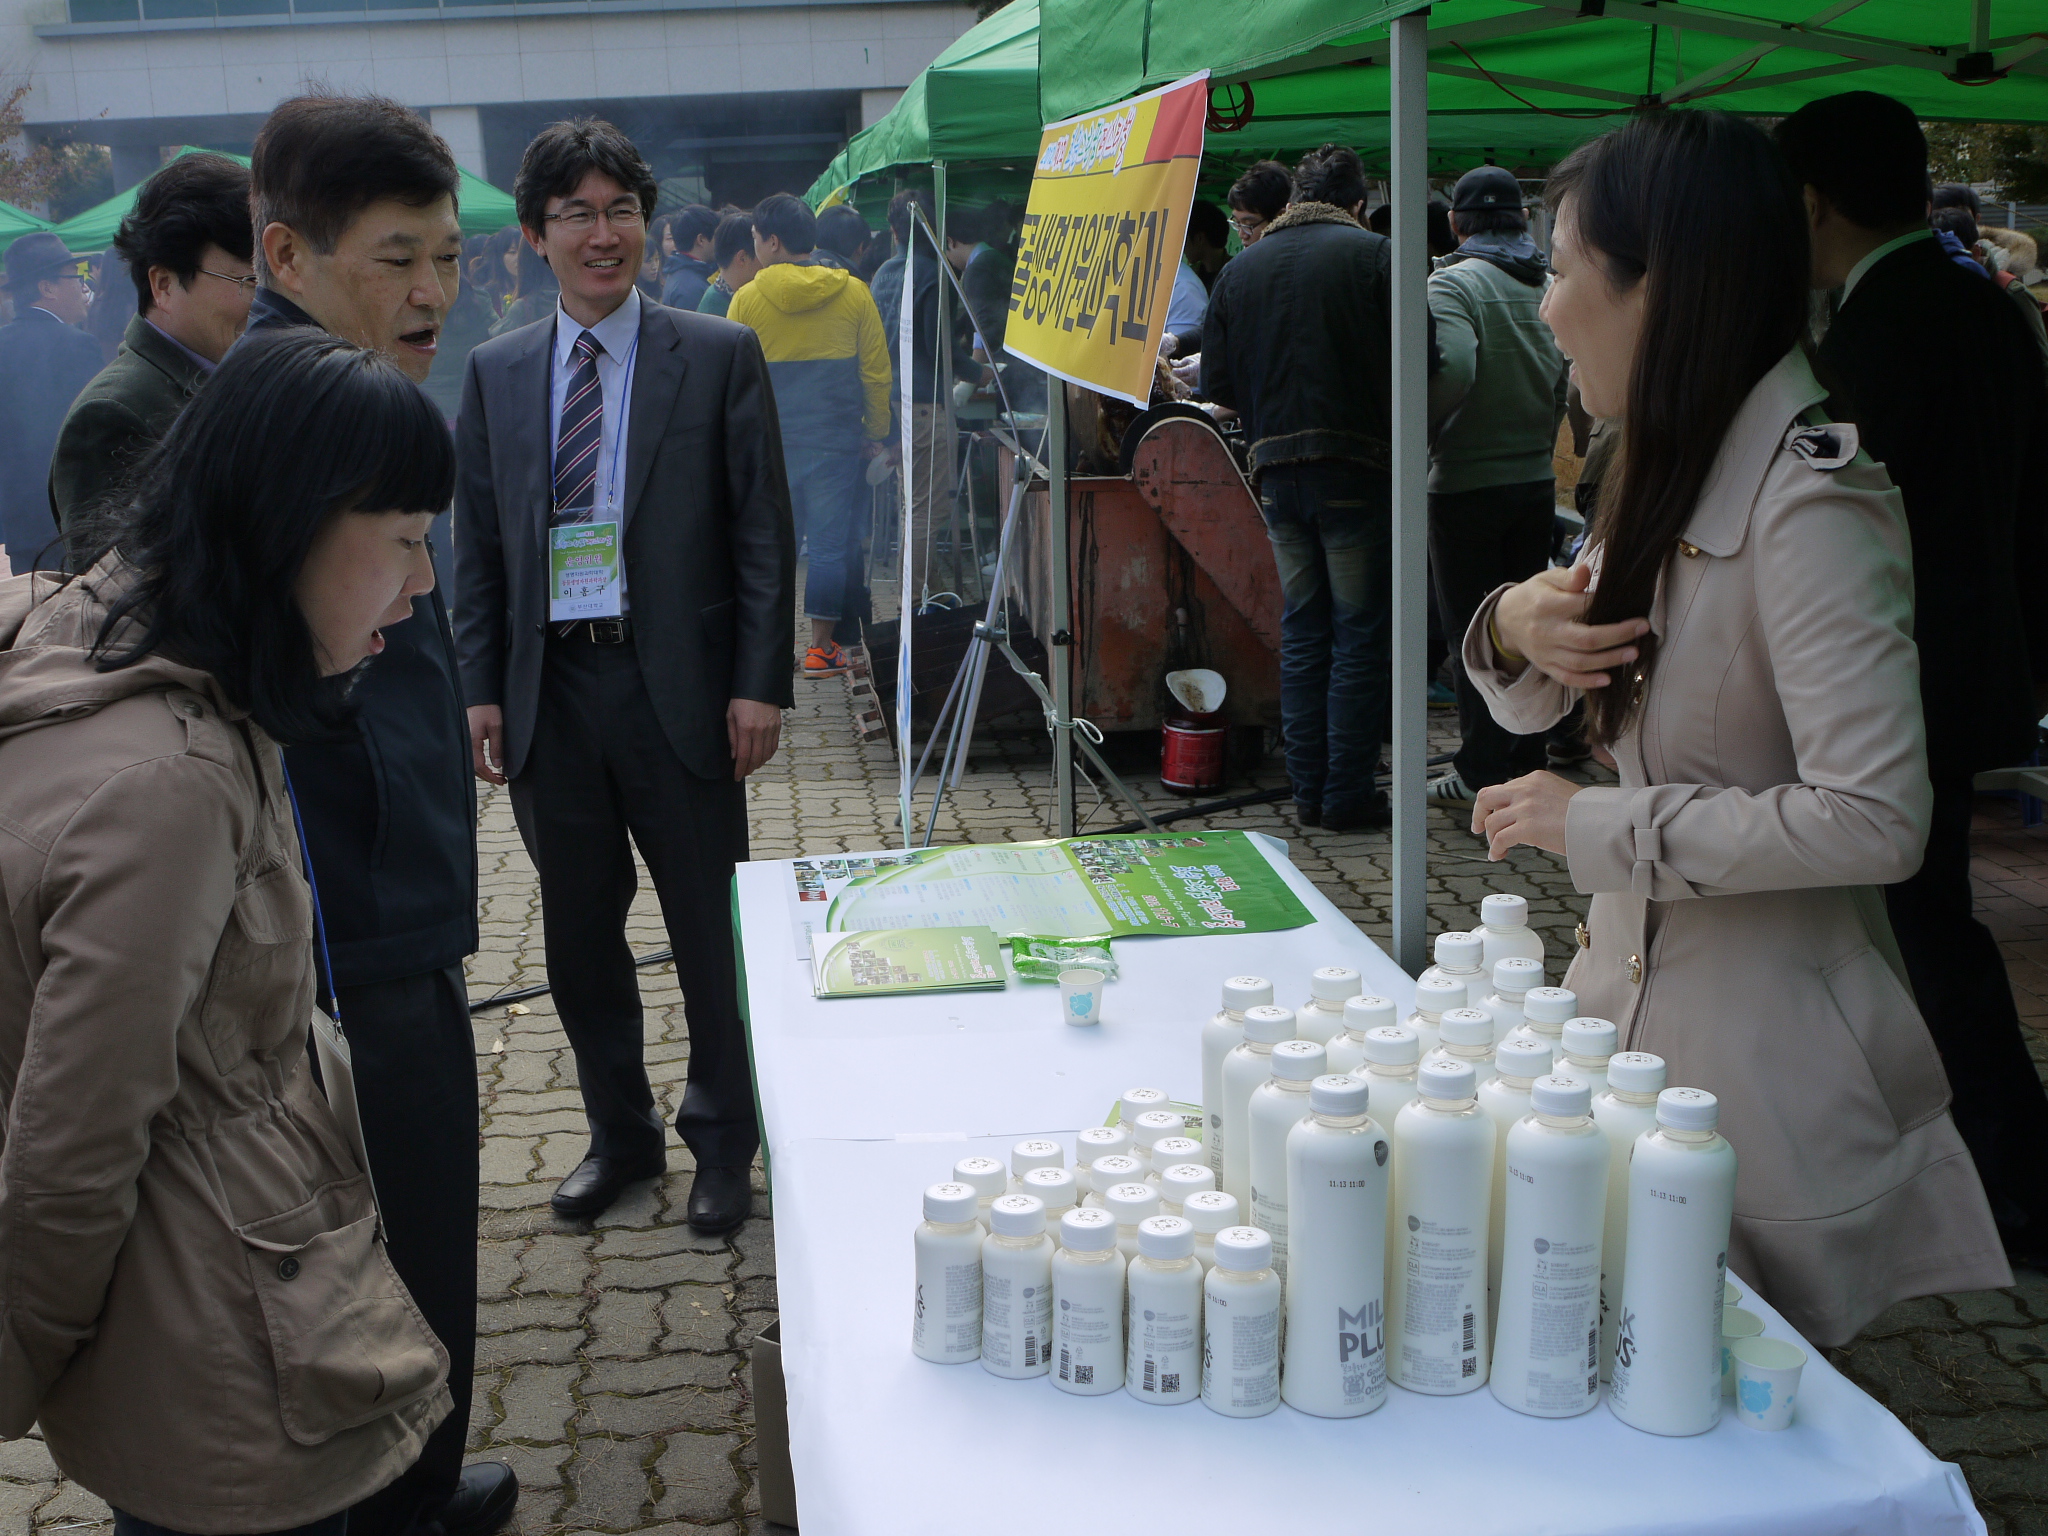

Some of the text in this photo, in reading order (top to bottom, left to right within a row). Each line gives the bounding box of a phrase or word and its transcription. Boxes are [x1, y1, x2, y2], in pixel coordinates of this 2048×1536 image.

[565, 554, 603, 567] 운영위원
[1329, 1180, 1365, 1188] 11.13 11:00
[1519, 1171, 1534, 1184] 11:00
[1650, 1189, 1687, 1205] 11.13 11:00
[1534, 1285, 1546, 1293] CLA
